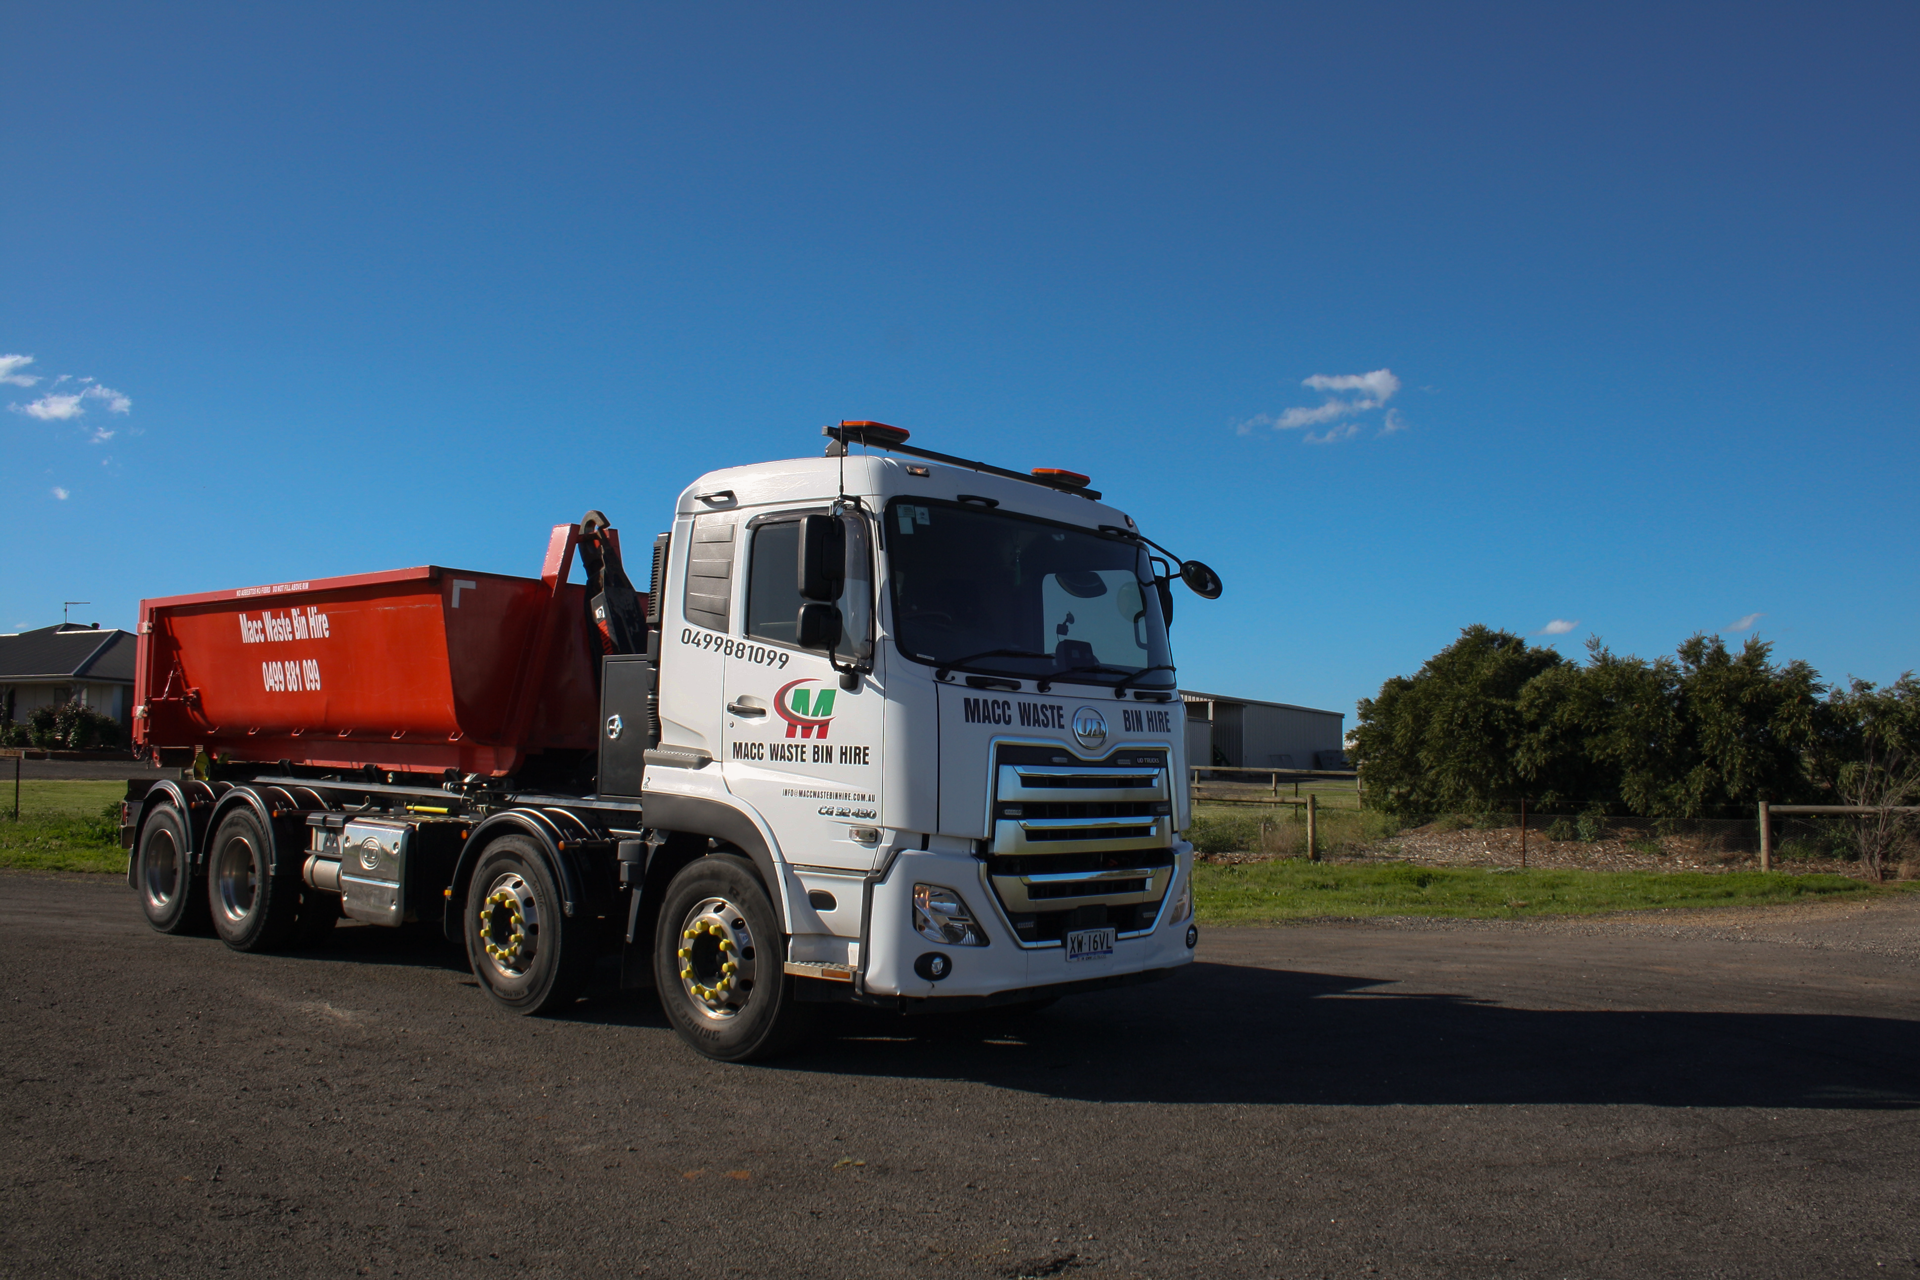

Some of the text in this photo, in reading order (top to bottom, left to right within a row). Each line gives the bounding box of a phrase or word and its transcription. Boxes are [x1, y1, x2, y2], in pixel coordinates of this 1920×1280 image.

[238, 606, 330, 644] Macc Waste Bin Hire
[681, 628, 790, 670] 0499881099
[262, 659, 321, 692] 0499 881 099
[963, 697, 1065, 730] MACC WASTE
[1122, 709, 1171, 733] BIN HIRE
[732, 741, 870, 765] MACC WASTE BIN HIRE
